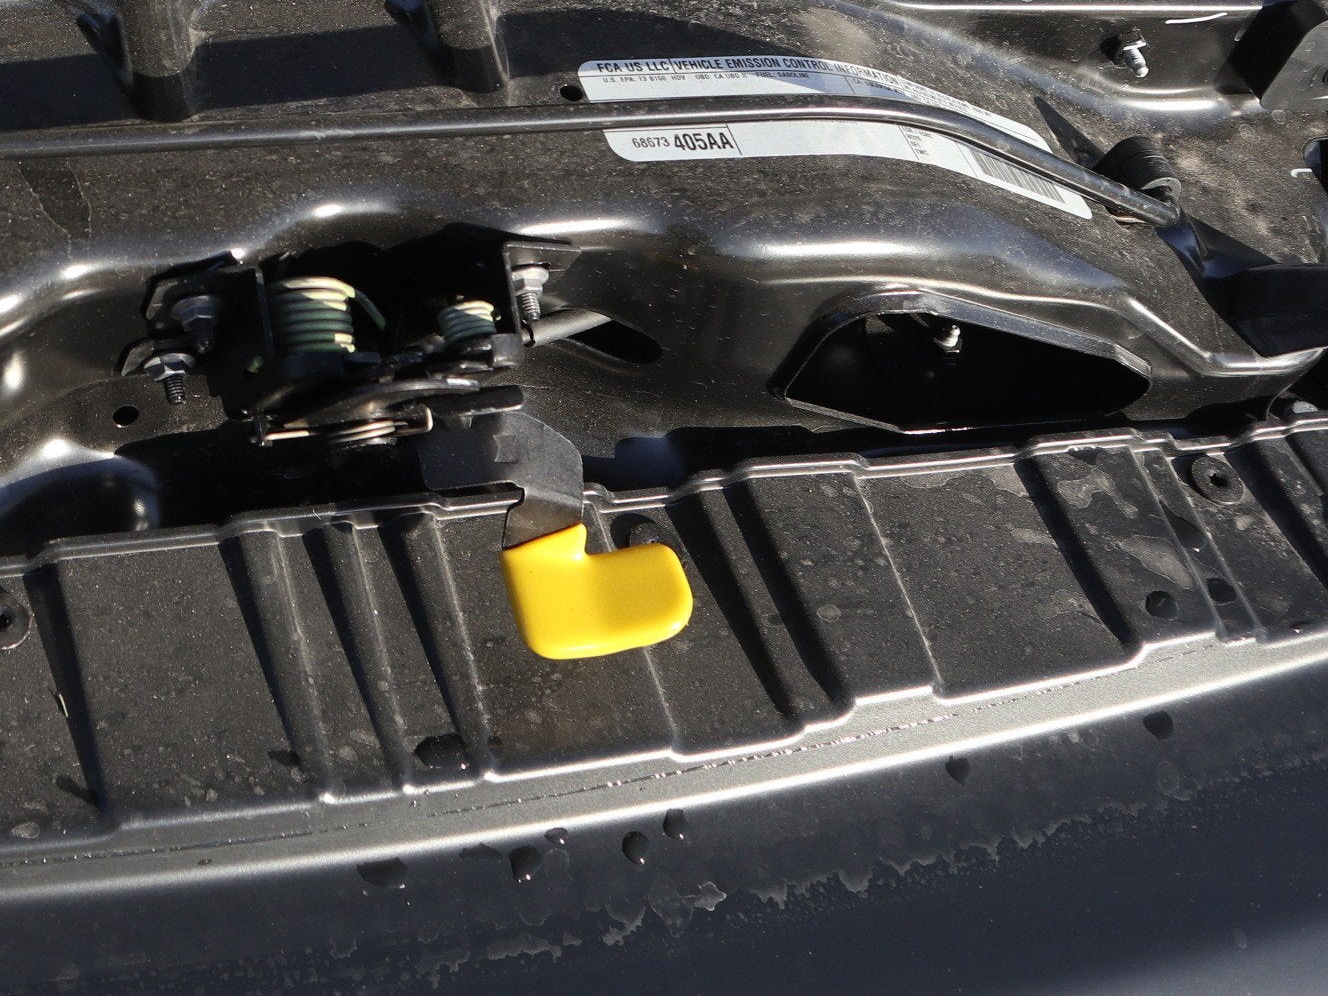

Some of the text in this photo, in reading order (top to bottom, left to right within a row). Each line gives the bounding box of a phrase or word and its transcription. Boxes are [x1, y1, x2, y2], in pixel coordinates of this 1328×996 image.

[596, 56, 899, 85] FCA US LLC VEHICLE EMISSION CONTROL INFORMATION
[632, 132, 734, 151] 68673 405AA
